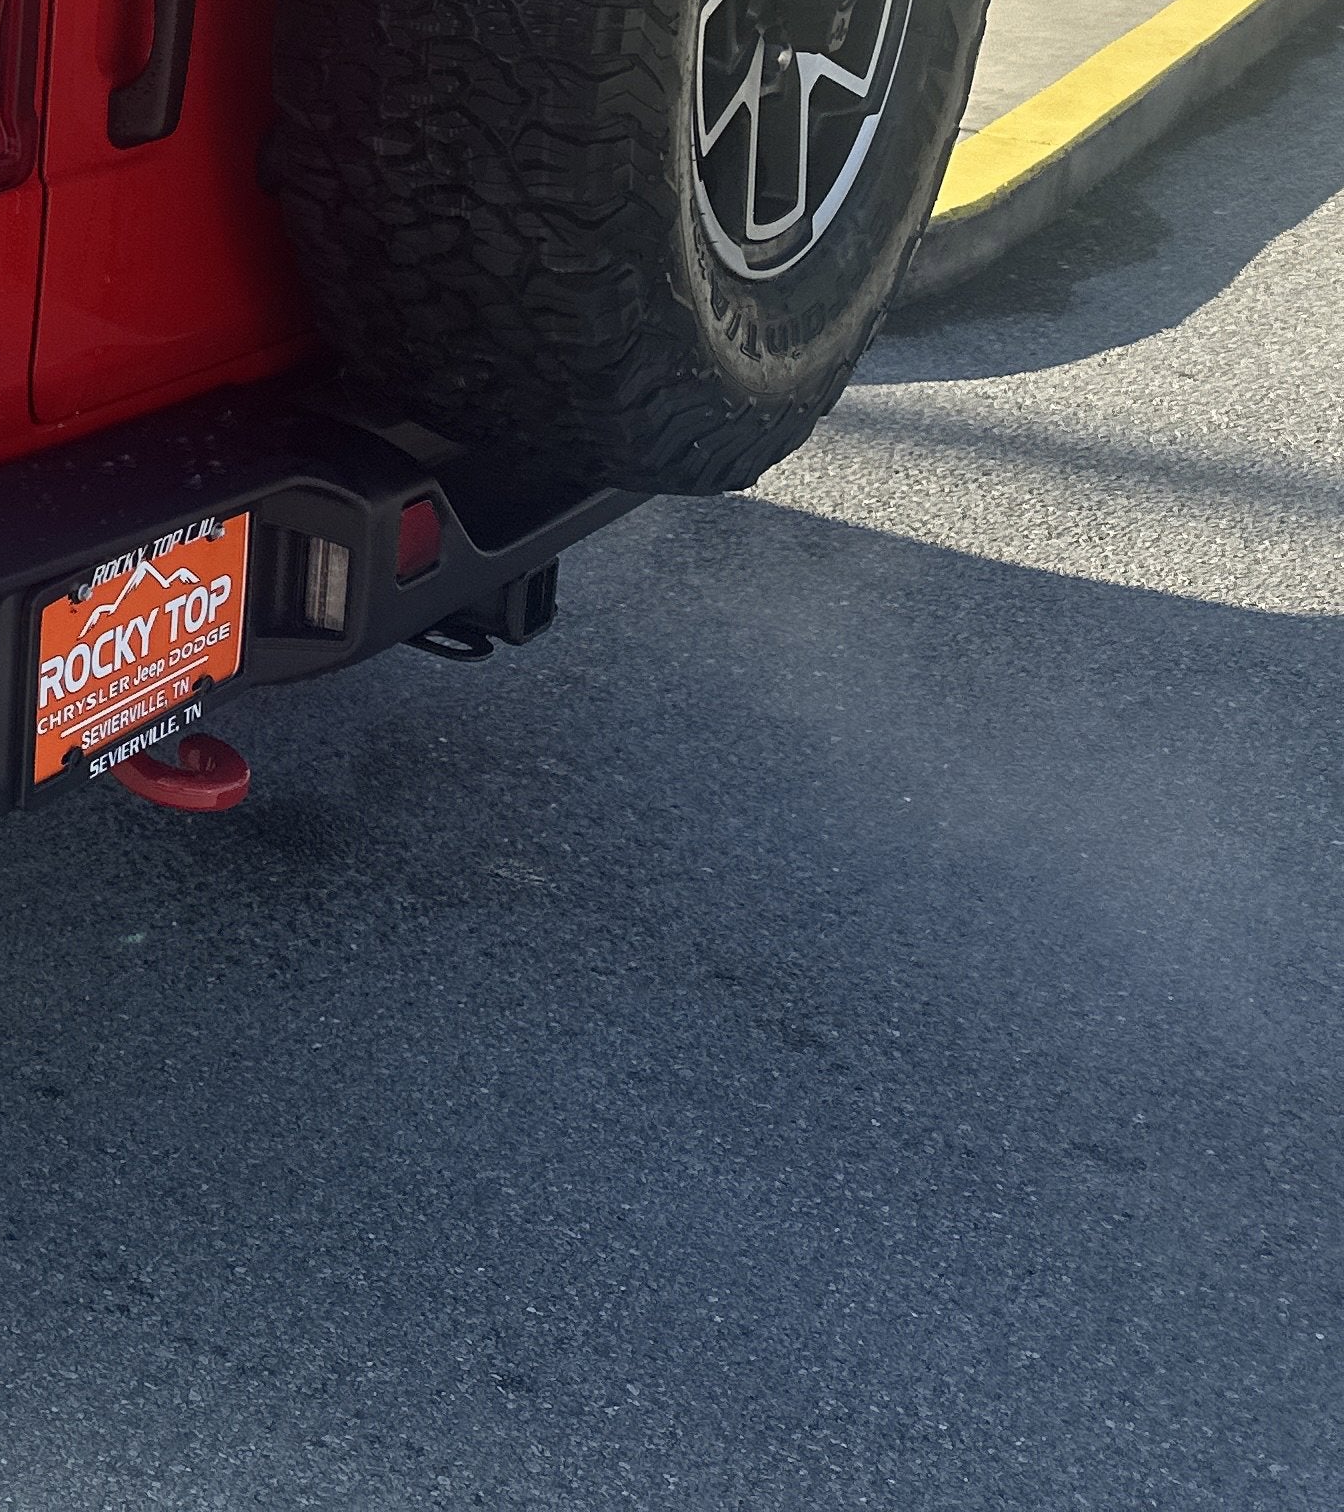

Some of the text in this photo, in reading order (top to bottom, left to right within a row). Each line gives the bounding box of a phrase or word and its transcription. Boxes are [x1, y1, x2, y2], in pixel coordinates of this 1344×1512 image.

[91, 544, 149, 588] ROCKY
[152, 528, 184, 561] TOP
[37, 622, 231, 735] CHRYSLER Jeep DODGE
[39, 574, 232, 709] ROCKY TOP
[81, 676, 191, 750] SEVIERVILLE, TN
[89, 701, 203, 779] SEVIERVILLE, TN
